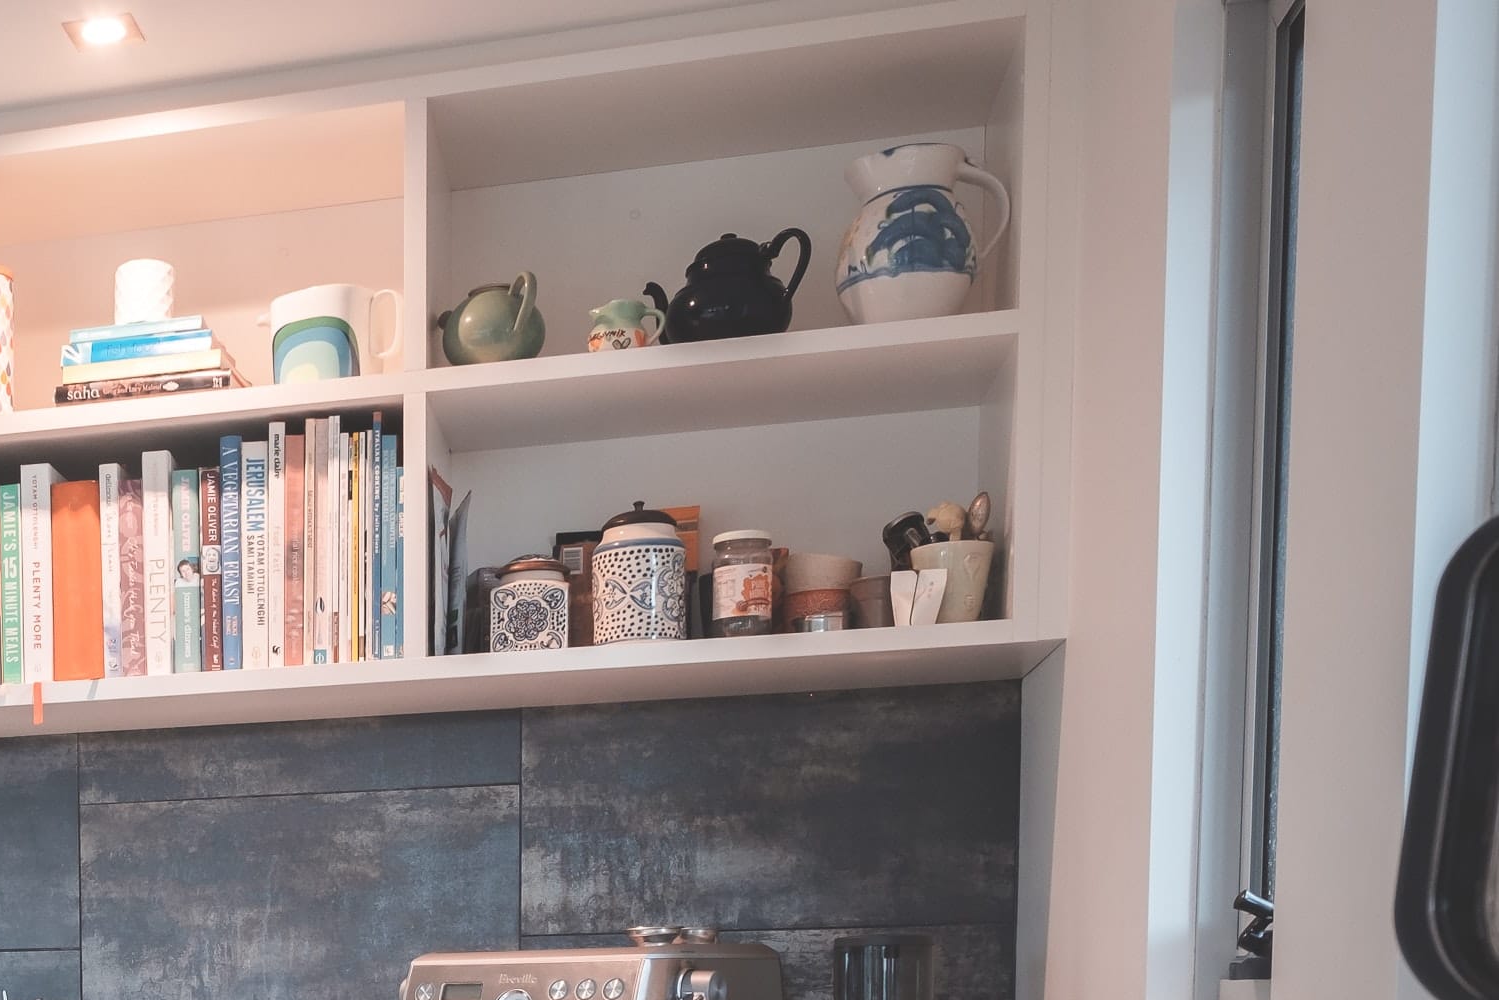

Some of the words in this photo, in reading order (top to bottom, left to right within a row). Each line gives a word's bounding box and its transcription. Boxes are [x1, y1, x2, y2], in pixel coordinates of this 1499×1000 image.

[66, 386, 100, 401] saha
[222, 447, 237, 456] A
[207, 473, 217, 504] JAMIE
[246, 457, 265, 532] JERUSALEM
[3, 492, 17, 551] JAMIE'S
[208, 505, 218, 542] OLIVER
[223, 461, 239, 553] VEGETARIAN
[182, 512, 191, 552] OLIVER
[246, 535, 255, 558] SAMI
[3, 557, 17, 579] 15
[256, 534, 264, 567] YOTAM
[32, 561, 41, 609] PLENTY
[225, 560, 240, 606] FEAST
[246, 561, 255, 594] TAMIMI
[4, 582, 18, 623] MINUTE
[148, 558, 166, 643] PLENTY
[256, 569, 265, 626] OTTOLENGHI
[5, 627, 19, 663] MEALS
[33, 614, 42, 650] MORE
[499, 972, 538, 984] Breville
